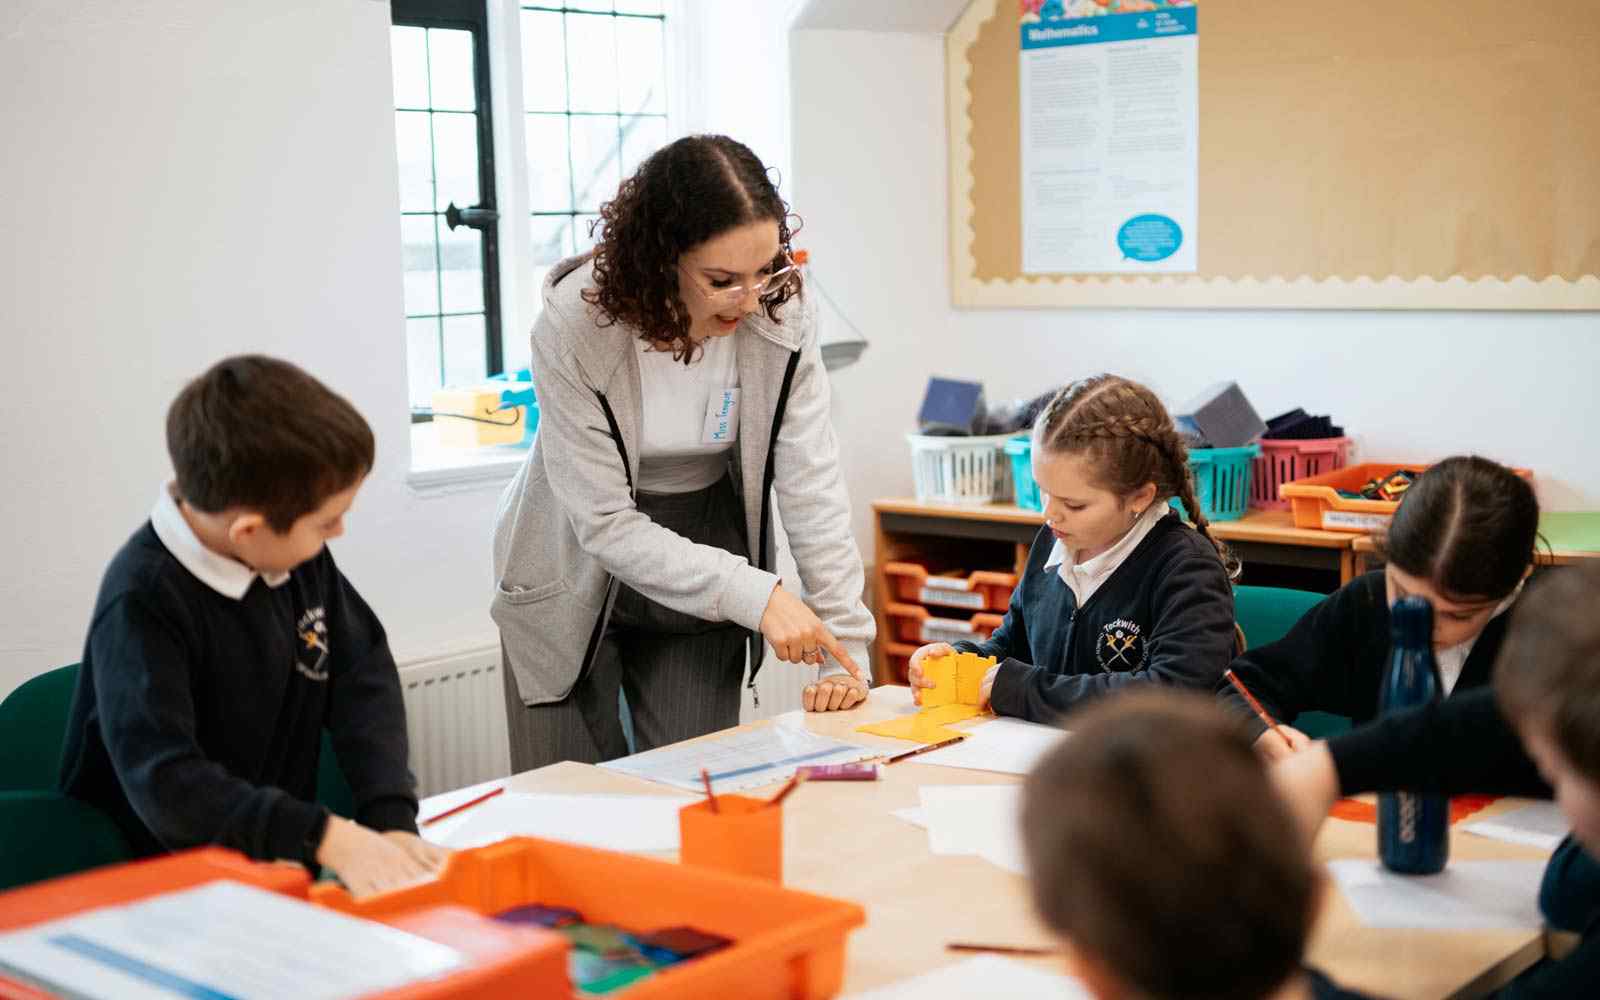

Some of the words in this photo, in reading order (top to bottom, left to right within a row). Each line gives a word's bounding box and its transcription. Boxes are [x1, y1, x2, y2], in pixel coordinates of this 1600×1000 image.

[1028, 24, 1099, 42] Mathematics
[712, 421, 727, 439] Miss
[1104, 618, 1140, 634] Tockwith
